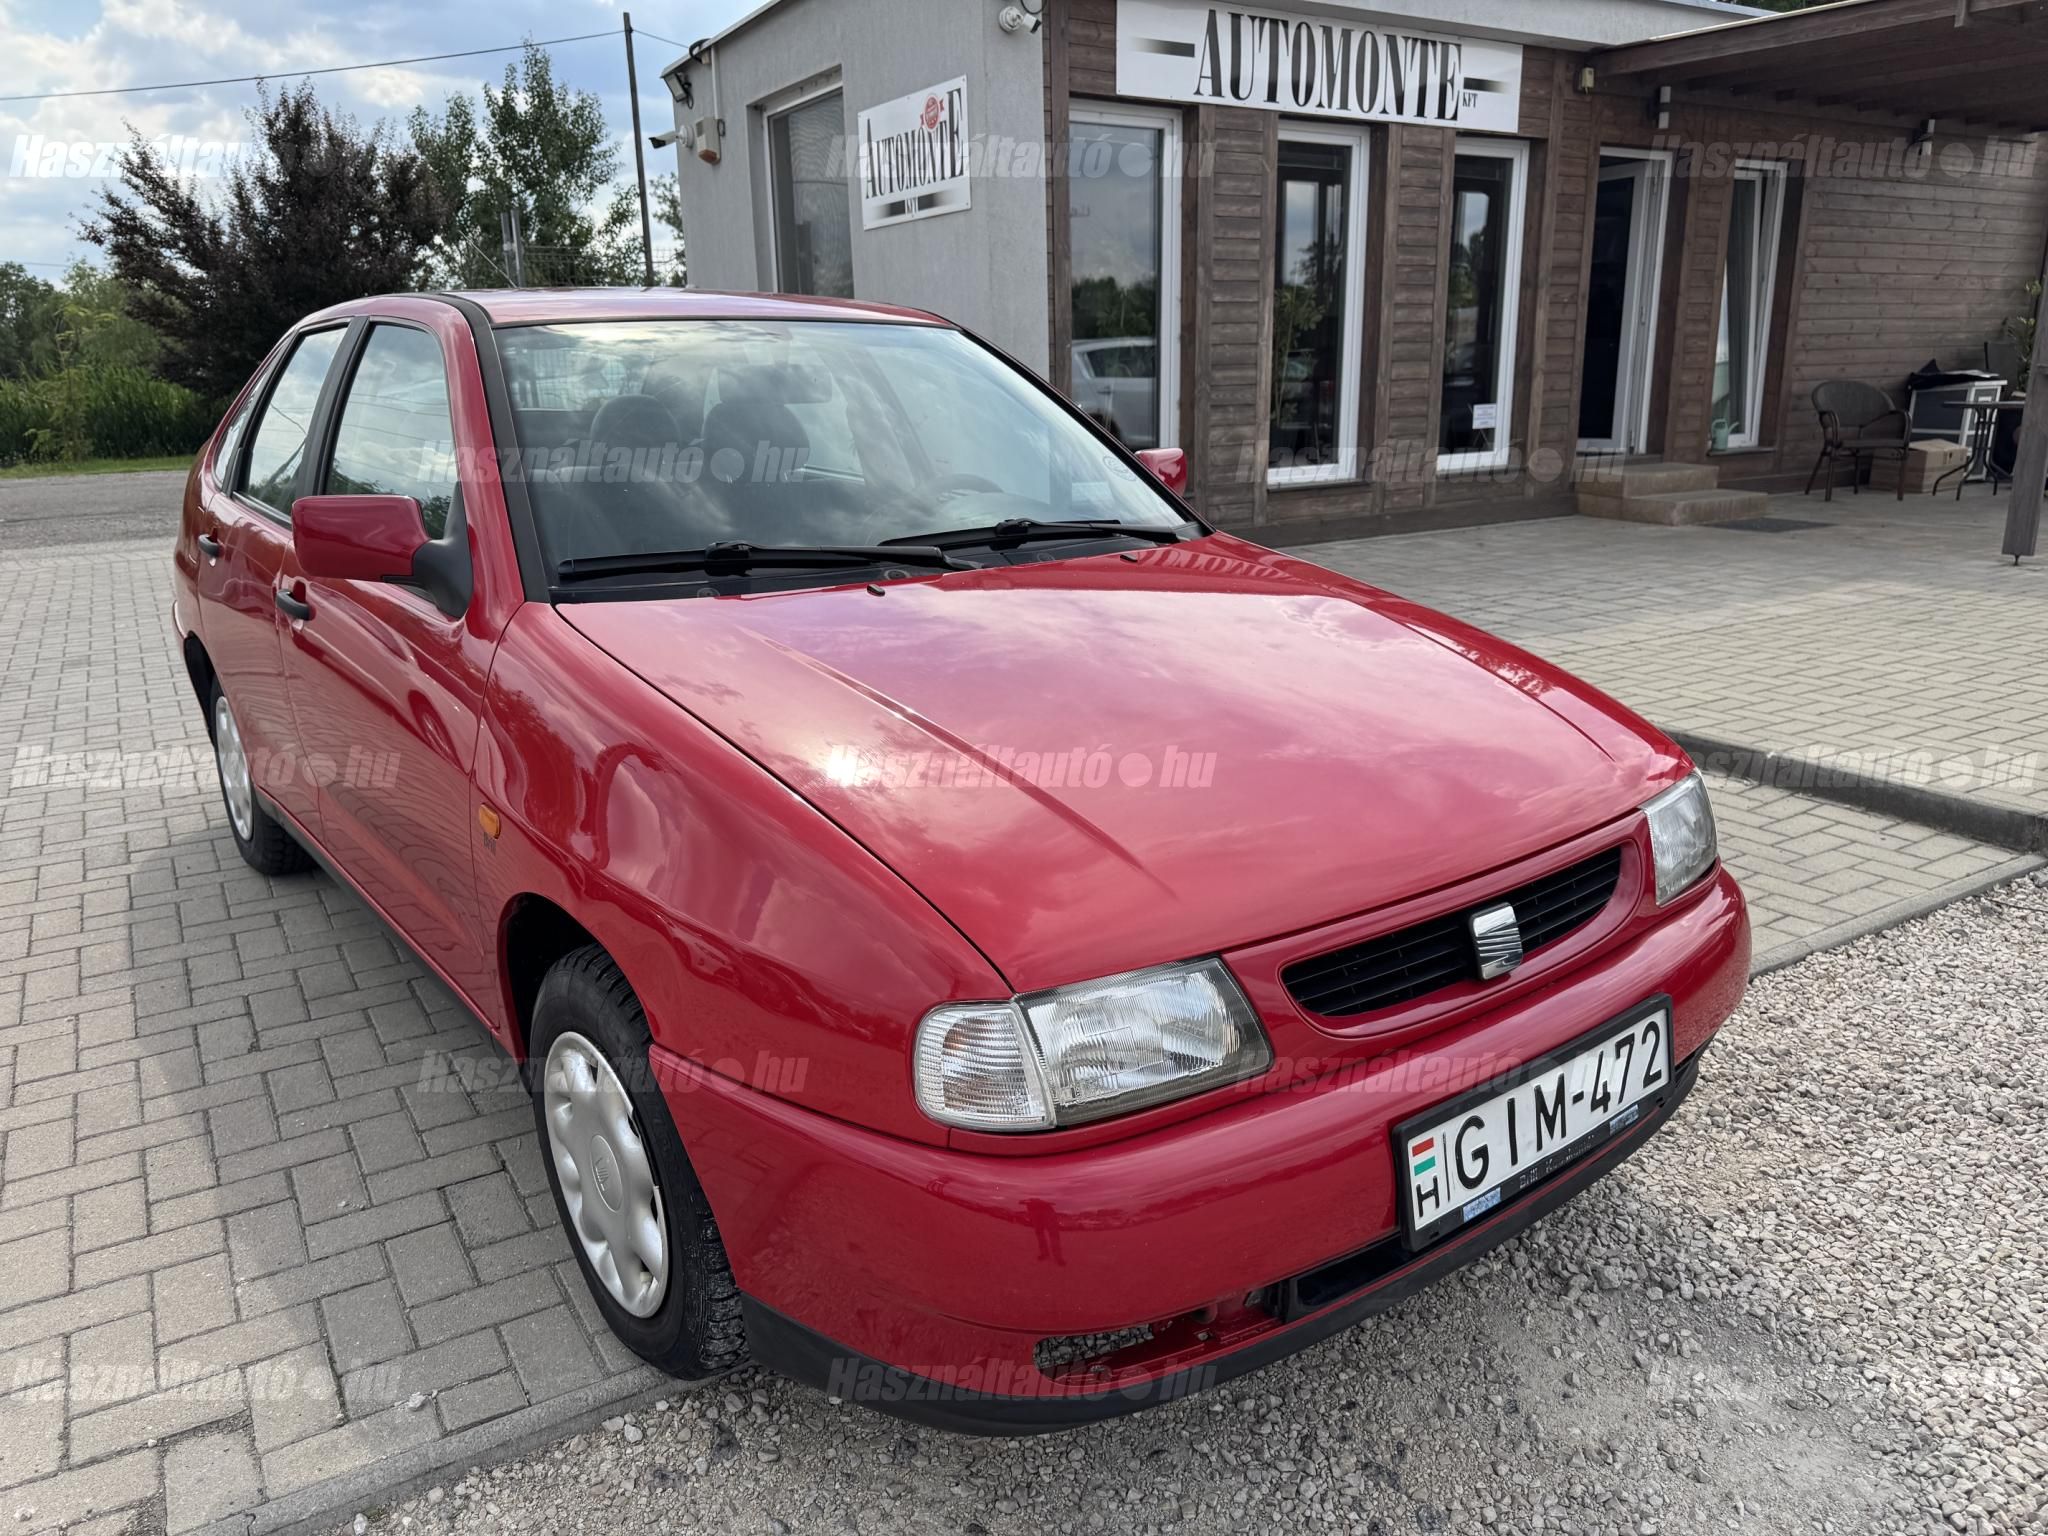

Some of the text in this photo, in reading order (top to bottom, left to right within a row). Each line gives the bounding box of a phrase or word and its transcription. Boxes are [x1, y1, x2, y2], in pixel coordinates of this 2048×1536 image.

[1194, 9, 1479, 121] AUTOMONTE KFT
[866, 88, 964, 199] AUTOMONTE
[1455, 1021, 1662, 1190] GIM-472
[1416, 1175, 1440, 1218] H
